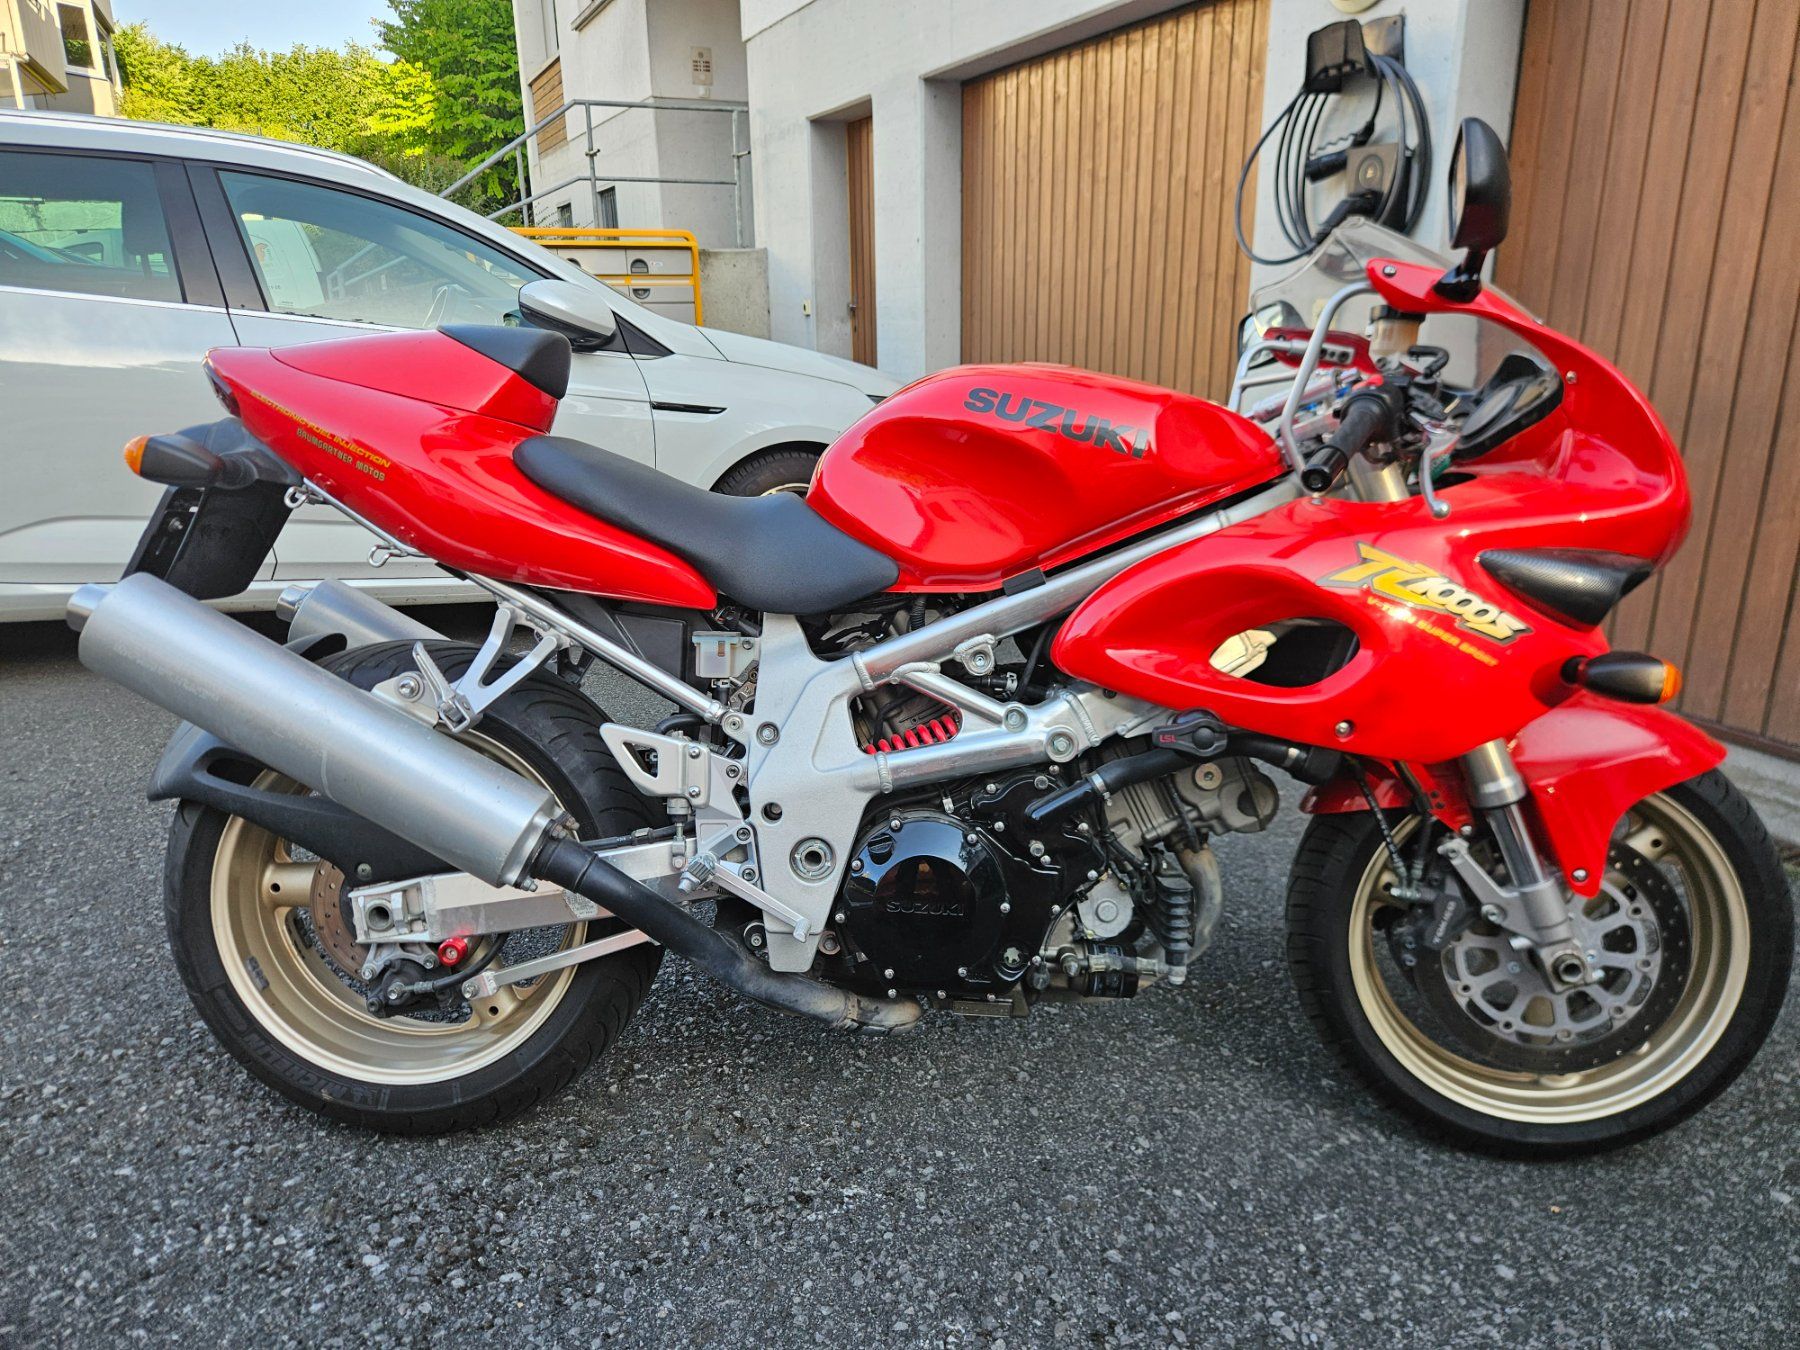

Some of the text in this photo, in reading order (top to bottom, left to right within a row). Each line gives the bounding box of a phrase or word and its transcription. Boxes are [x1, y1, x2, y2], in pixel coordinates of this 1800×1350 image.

[307, 421, 333, 440] FUEL
[333, 435, 392, 468] INJECTION
[963, 387, 1149, 459] SUZUKI
[296, 428, 386, 481] BAUMGARTNER MOTOS
[1317, 541, 1534, 646] TL1000S
[886, 900, 964, 916] SUZUKI
[244, 1033, 348, 1098] MICHELIN
